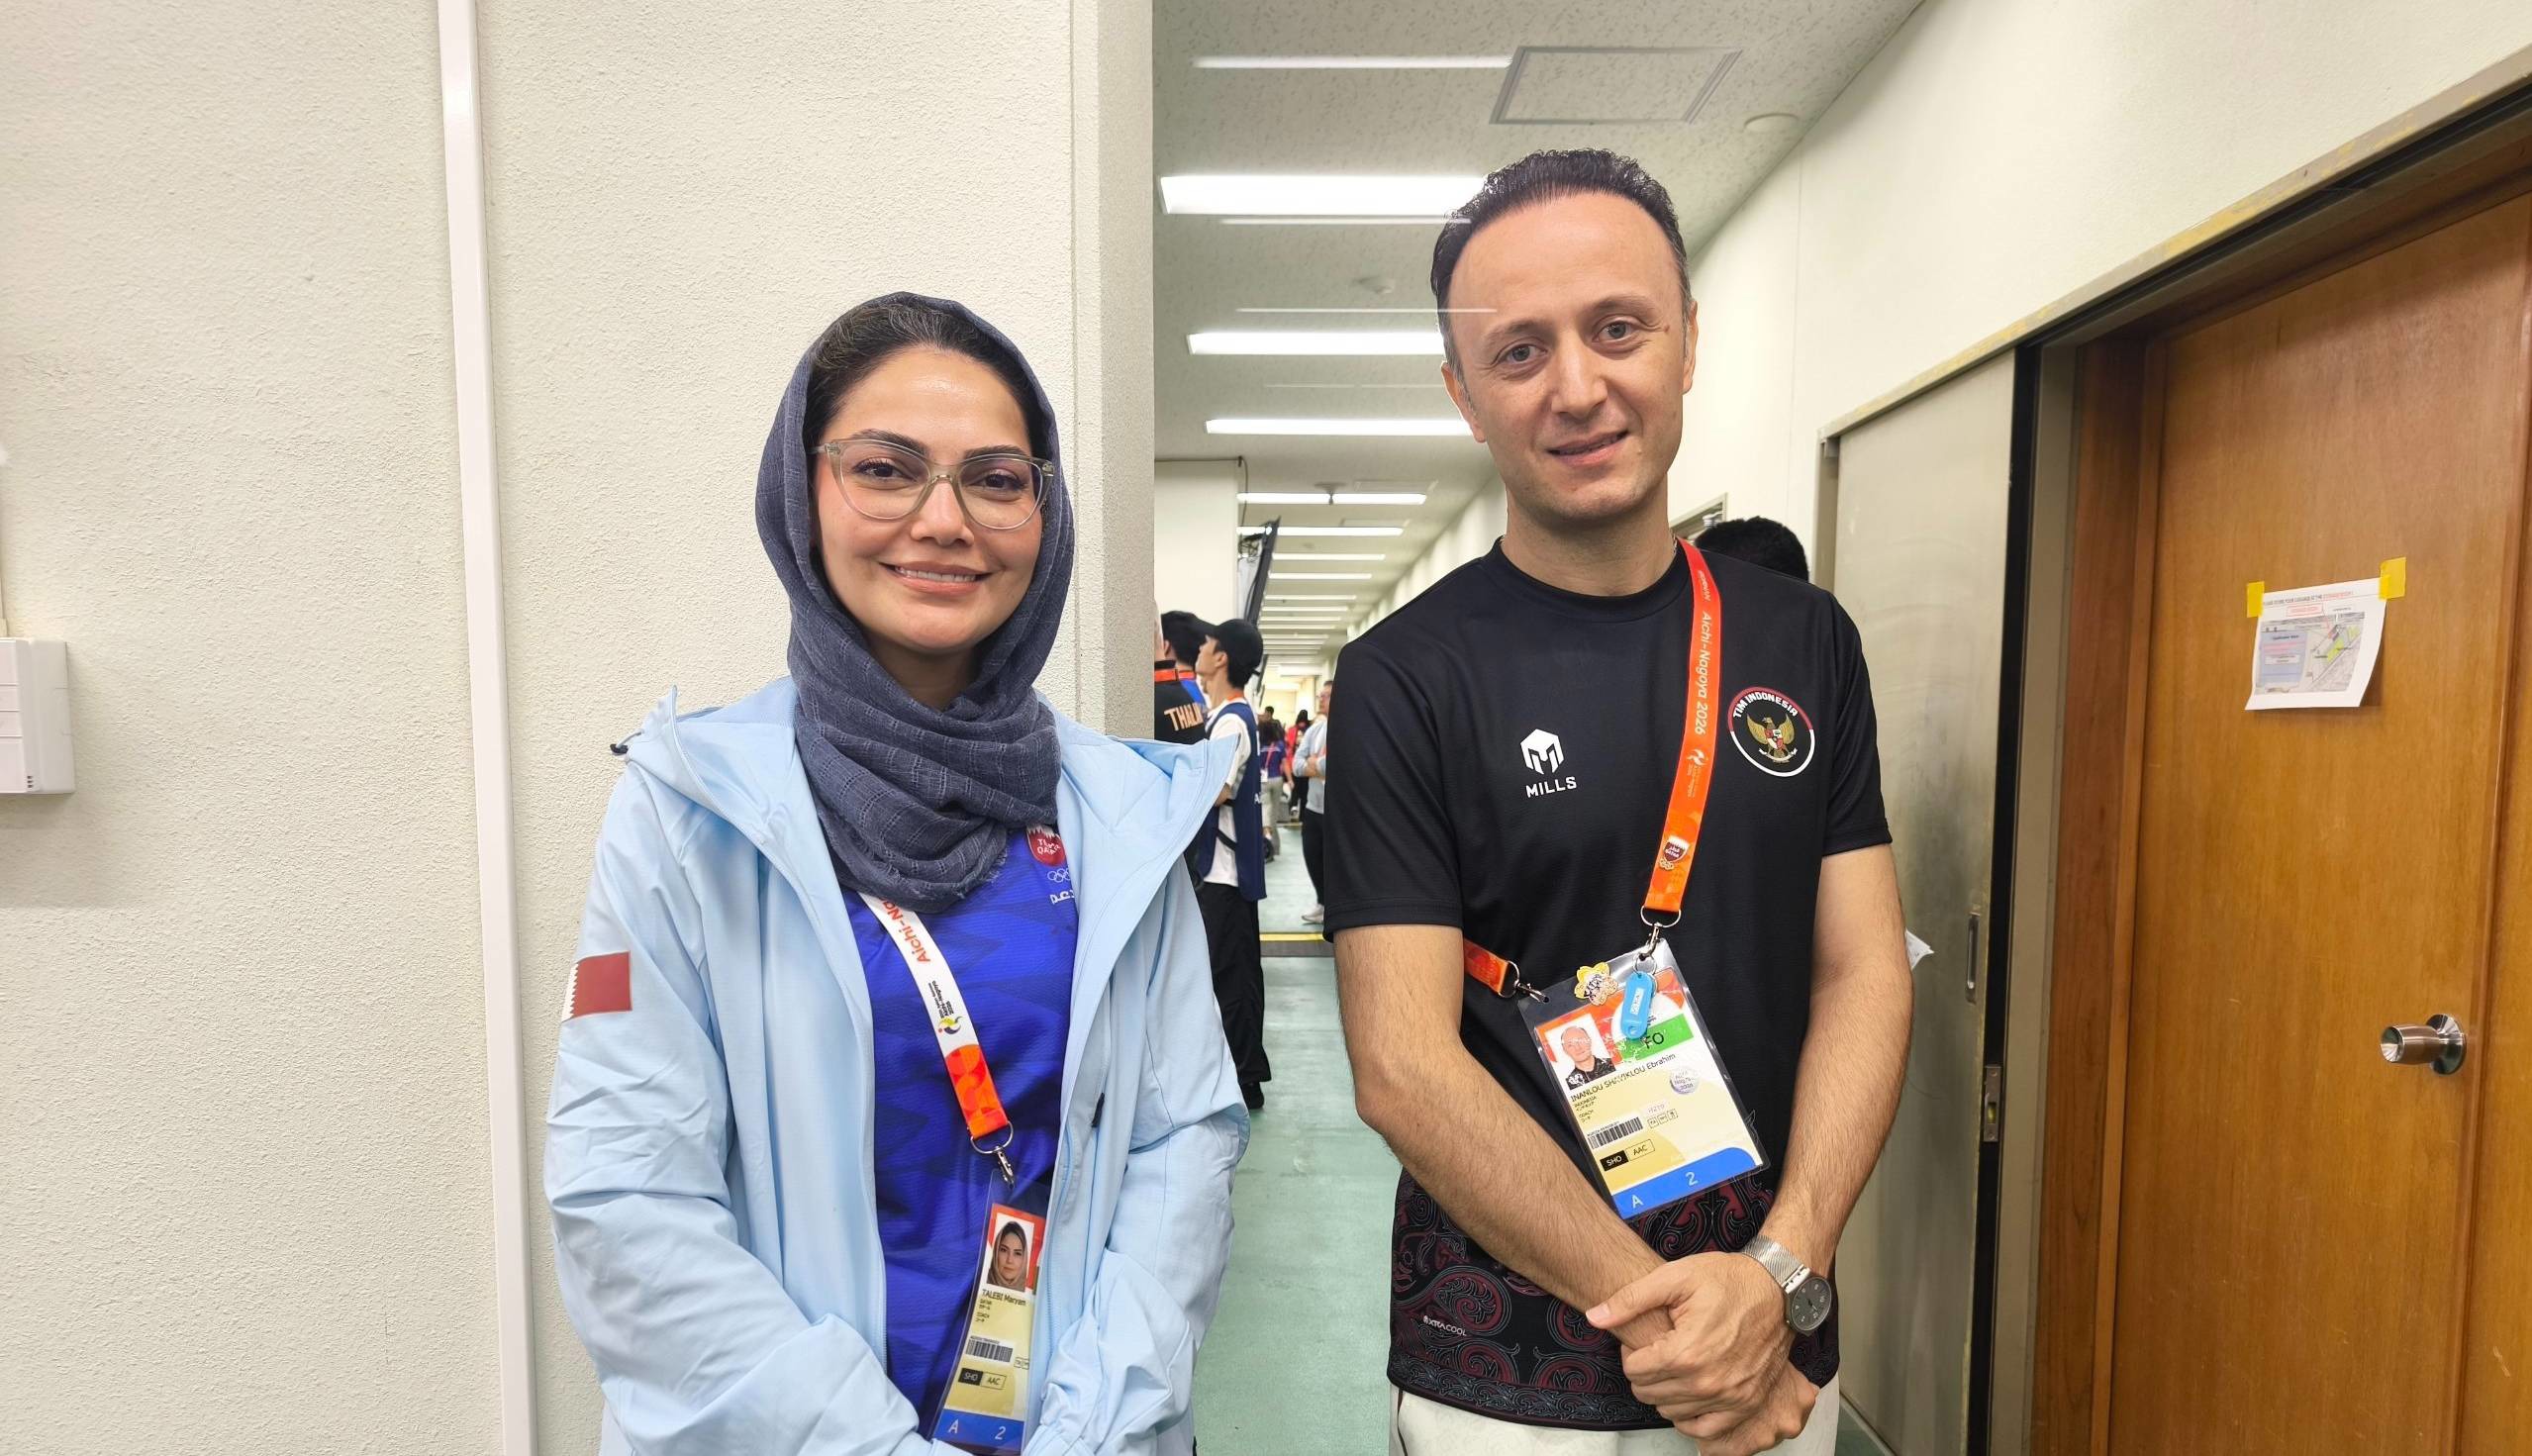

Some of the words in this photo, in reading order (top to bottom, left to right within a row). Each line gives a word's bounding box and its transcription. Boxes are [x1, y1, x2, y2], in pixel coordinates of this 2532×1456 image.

[1695, 611, 1712, 699] Aichi-Nagoya
[1695, 700, 1709, 736] 2026
[1733, 699, 1748, 719] TIM
[1746, 691, 1799, 717] INDONESIA
[1525, 776, 1578, 798] MILLS
[880, 898, 931, 963] Aichi-Na
[1571, 1083, 1604, 1102] INANLOU
[1646, 1053, 1676, 1070] Ebrahim
[1606, 1154, 1623, 1168] SHO
[1632, 1144, 1648, 1156] AAC
[1631, 1195, 1643, 1209] A
[1686, 1171, 1698, 1186] 2
[963, 1370, 978, 1382] SHO
[987, 1375, 1000, 1386] AAC
[947, 1418, 959, 1434] A
[995, 1425, 1007, 1440] 2
